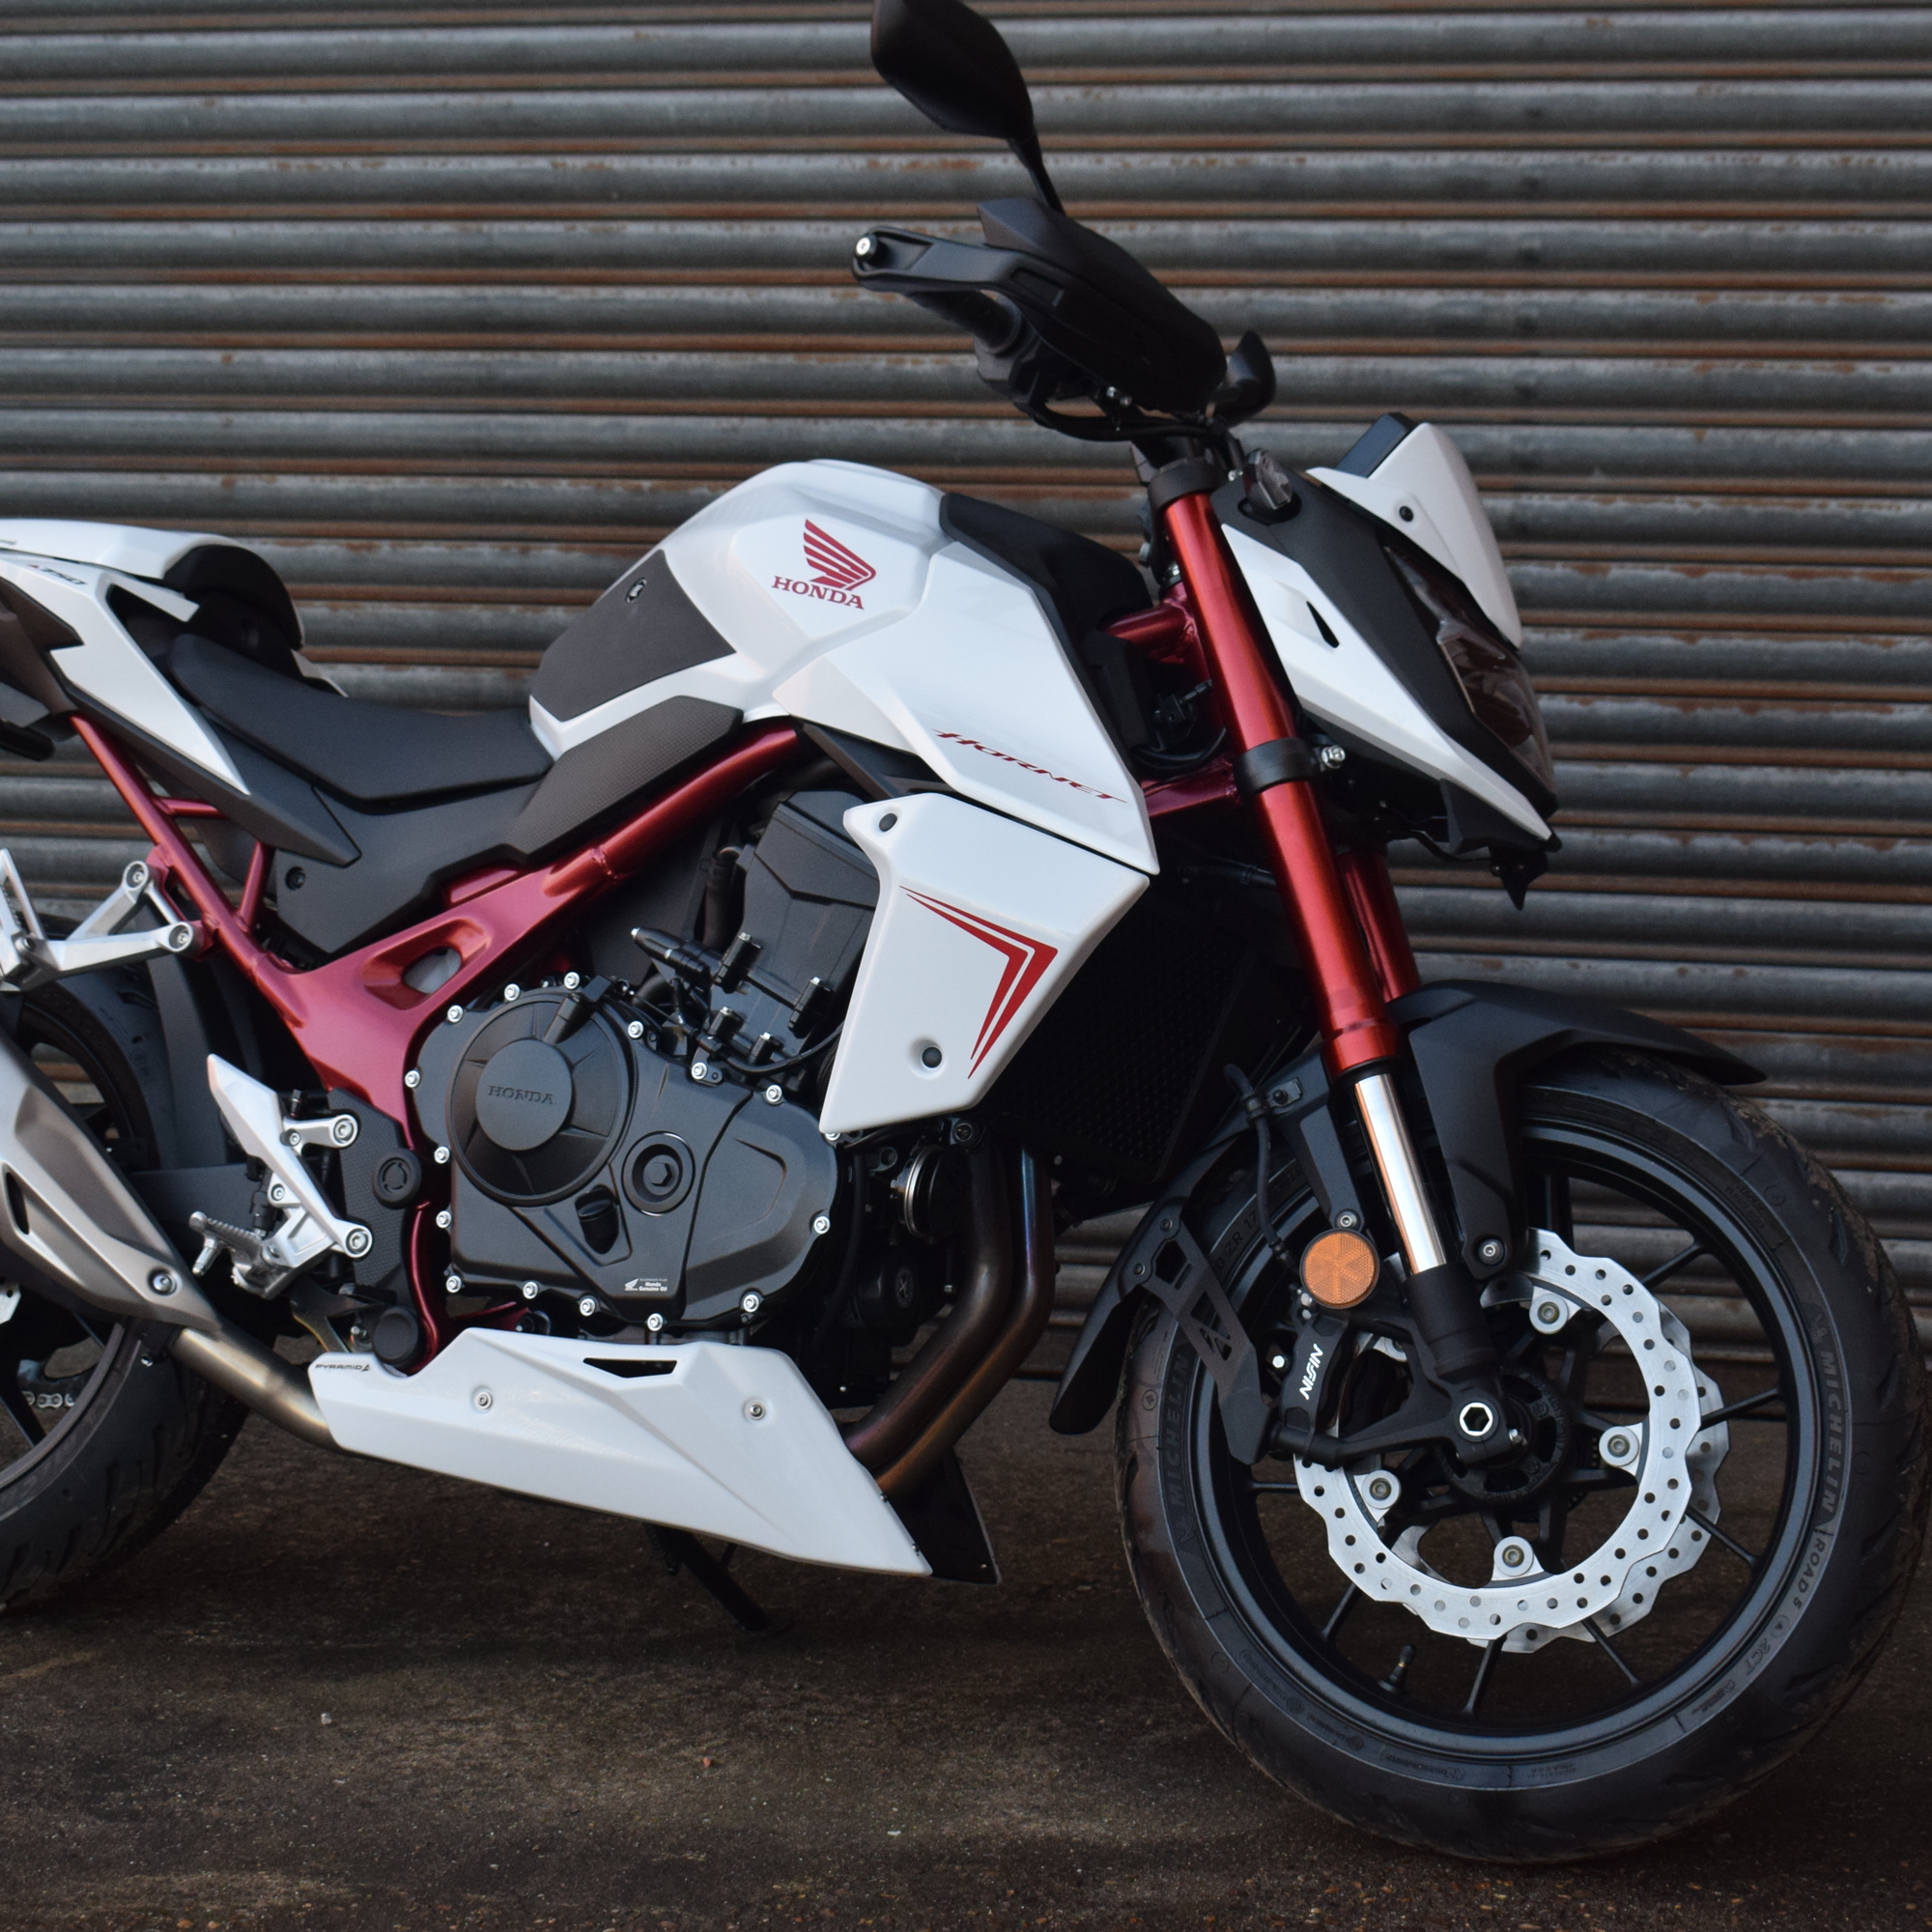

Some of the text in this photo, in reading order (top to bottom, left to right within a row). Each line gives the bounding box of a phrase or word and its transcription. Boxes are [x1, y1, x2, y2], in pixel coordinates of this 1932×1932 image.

[771, 575, 865, 611] HONDA
[488, 1085, 556, 1104] HONDA
[1299, 1343, 1323, 1400] NISSIN
[1165, 1353, 1190, 1507] MICHELIN
[1820, 1350, 1843, 1514] MICHELIN
[1797, 1538, 1826, 1594] ROAD
